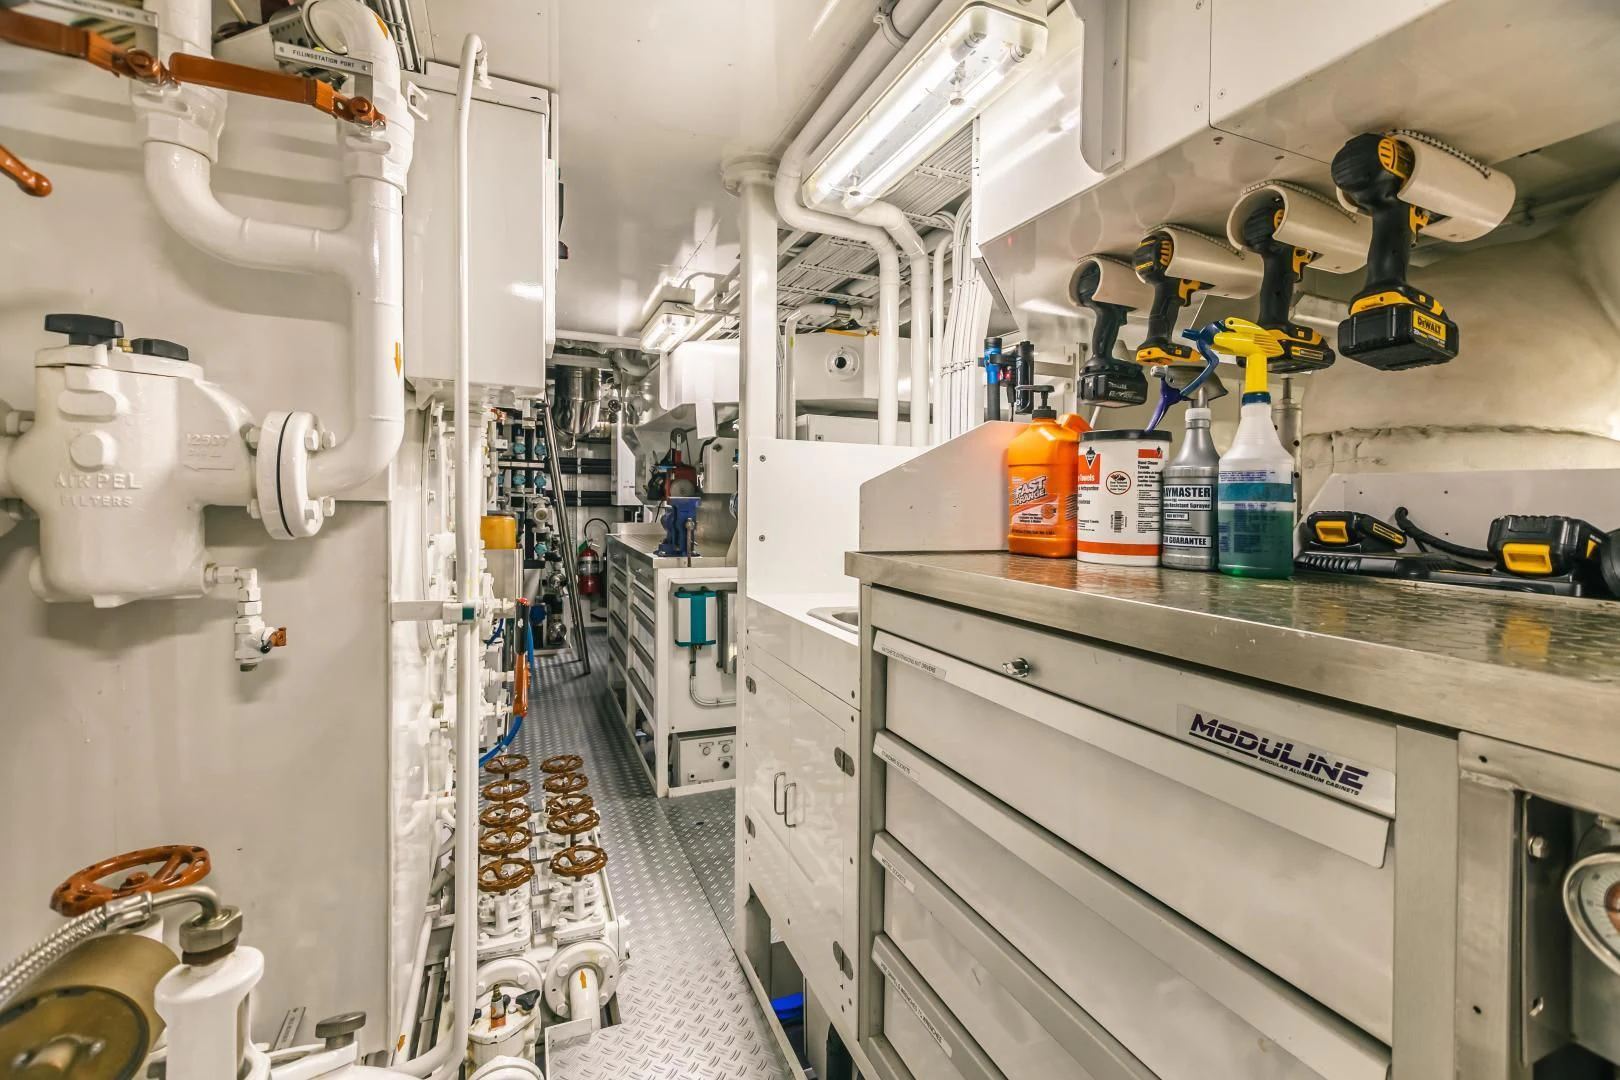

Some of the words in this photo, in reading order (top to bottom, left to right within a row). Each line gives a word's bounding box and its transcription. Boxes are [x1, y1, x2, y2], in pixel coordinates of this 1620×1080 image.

[292, 49, 338, 65] FILLINGSTATION
[340, 60, 355, 68] PORT
[1014, 475, 1047, 499] FAST
[59, 495, 134, 508] FILTERS
[1013, 488, 1048, 507] ORANGE
[1168, 536, 1207, 546] GUARANTEE
[1190, 713, 1369, 790] MODULINE
[1259, 756, 1288, 771] MODULAR
[1289, 767, 1325, 784] ALUMINUM
[1325, 780, 1361, 796] CABINETS
